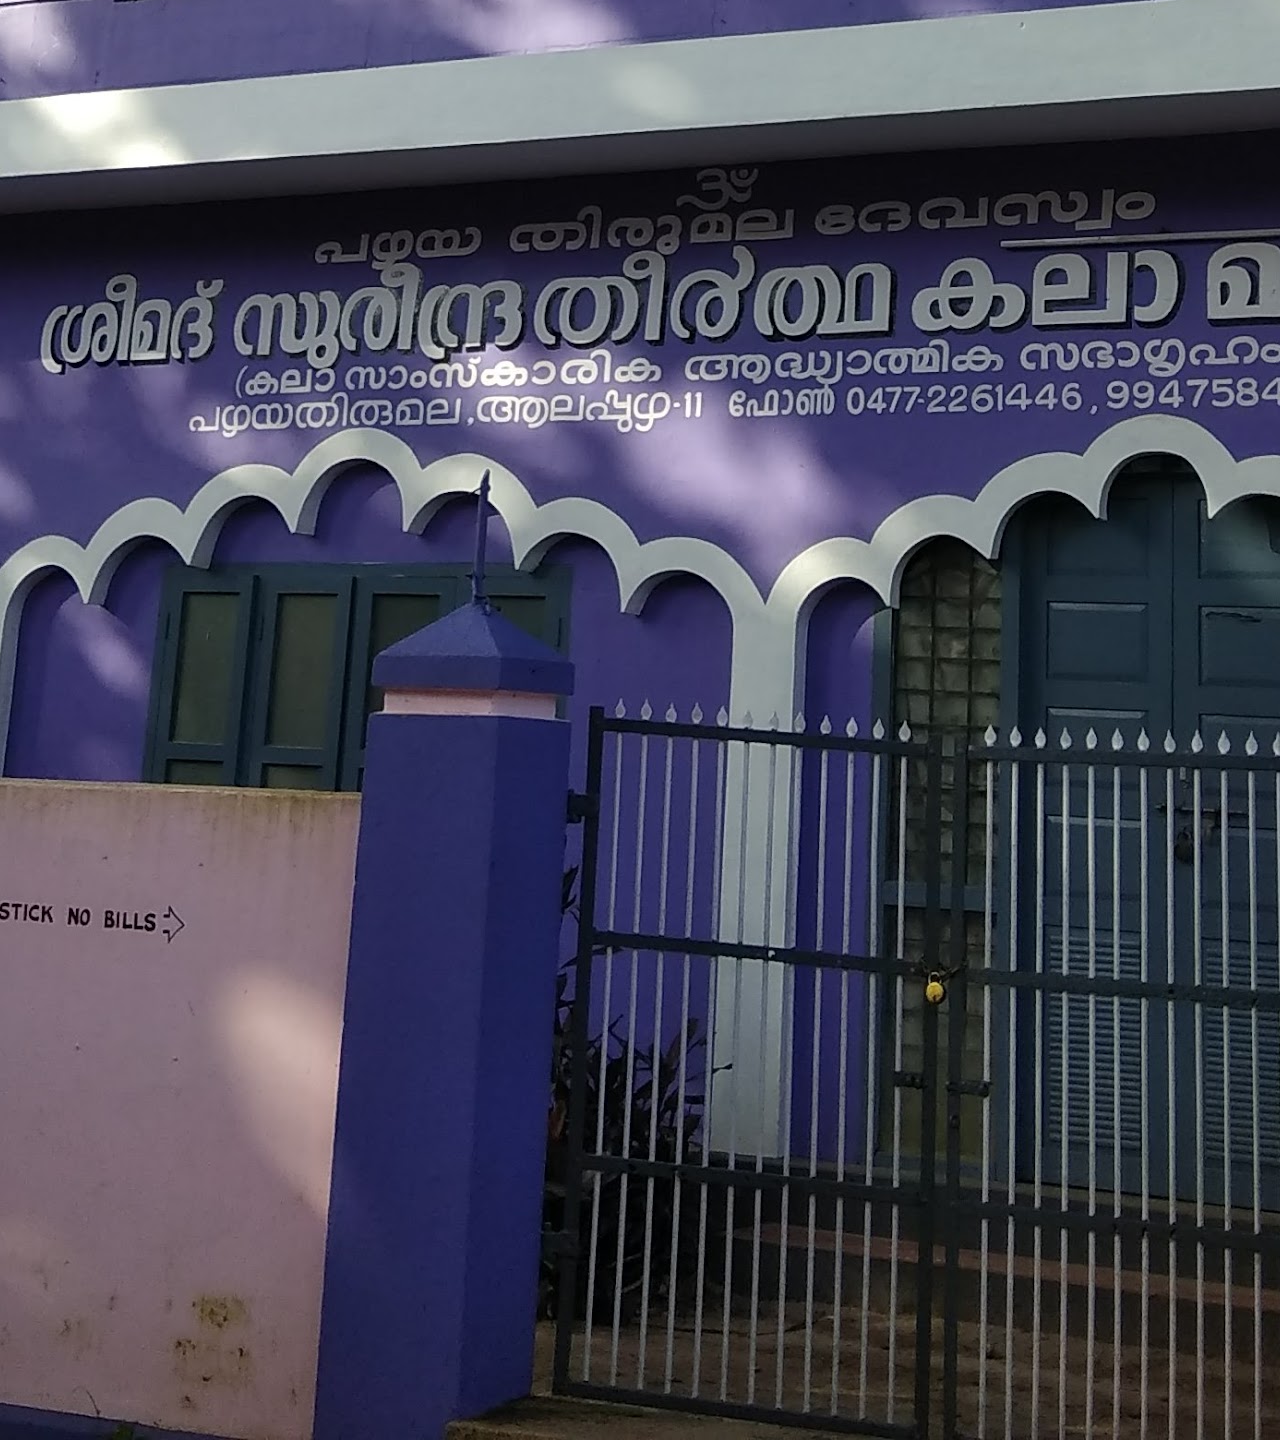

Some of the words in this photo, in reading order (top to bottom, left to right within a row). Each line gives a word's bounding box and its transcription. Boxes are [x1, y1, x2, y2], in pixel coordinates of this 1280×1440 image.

[314, 225, 483, 270] പഴയ
[508, 205, 795, 256] തിരുമല
[814, 188, 1157, 236] ദേവസ്വം
[40, 273, 225, 375] ശ്രീമദ്
[911, 248, 1182, 333] കലാ
[728, 385, 836, 418] ഫോൺ
[67, 907, 91, 926] NO
[103, 910, 157, 932] BILLS
